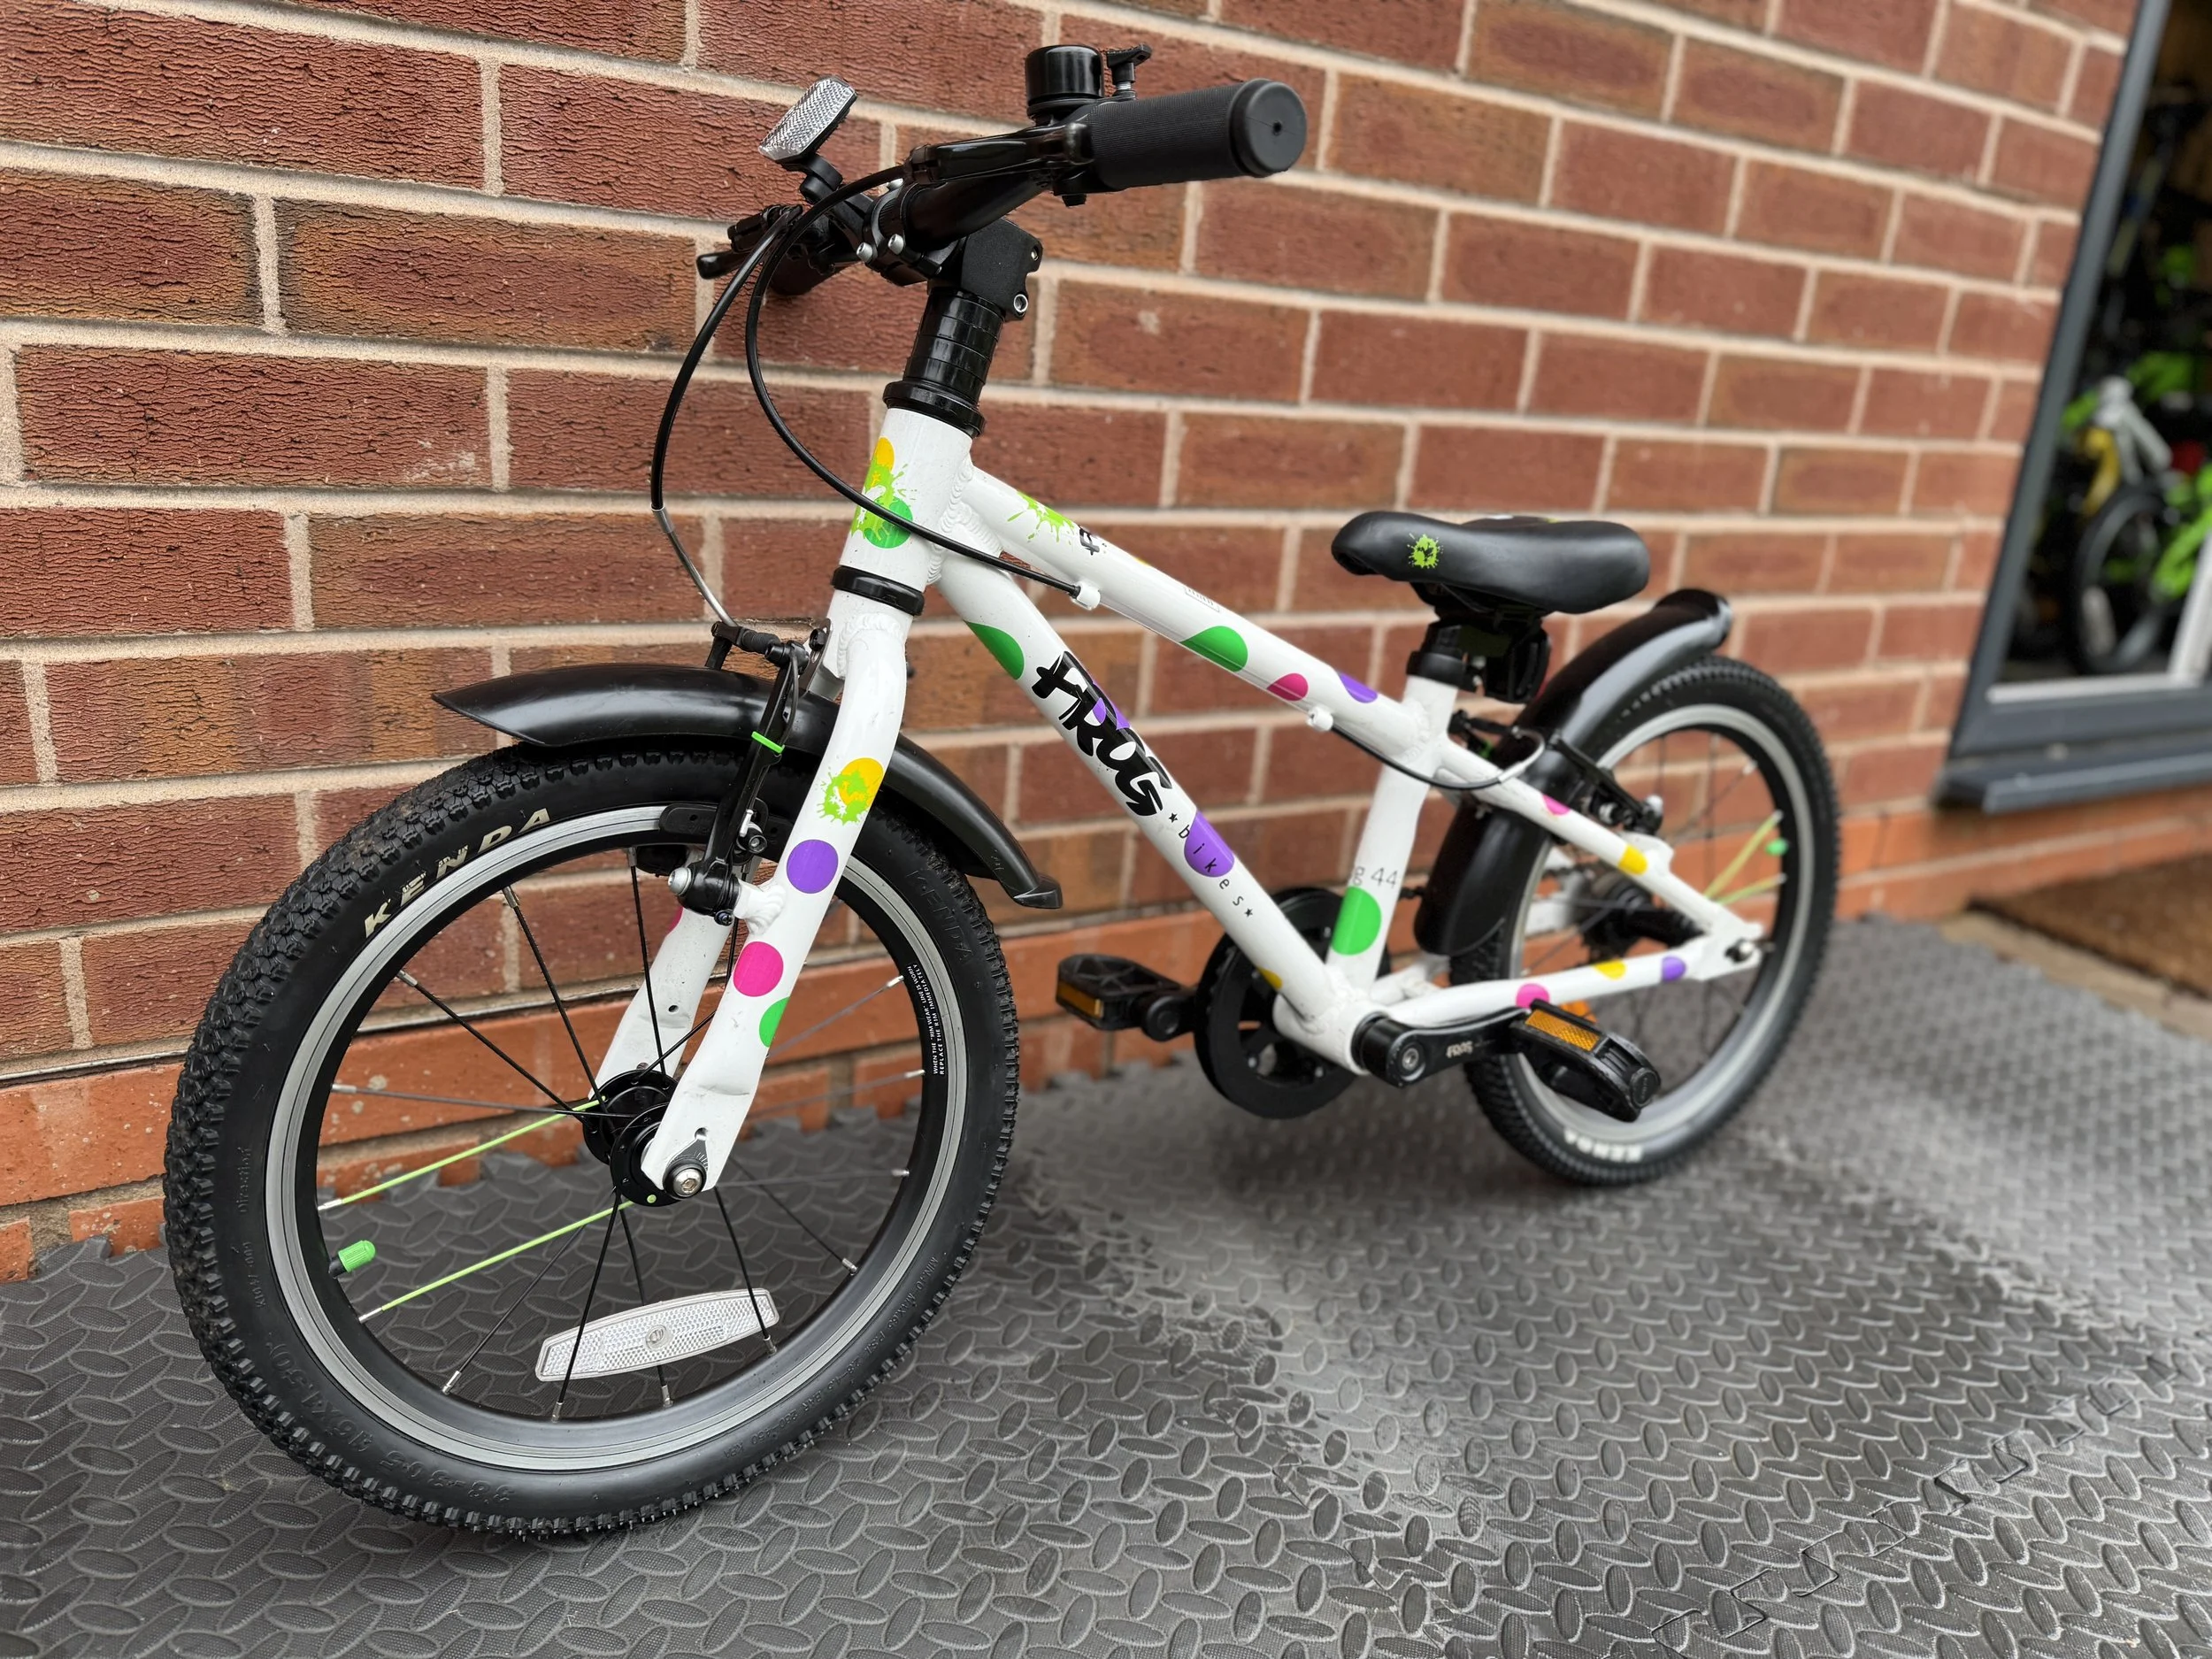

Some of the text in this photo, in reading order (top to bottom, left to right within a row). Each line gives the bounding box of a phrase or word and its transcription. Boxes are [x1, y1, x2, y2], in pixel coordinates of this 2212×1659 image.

[365, 808, 550, 938] KENDA
[1178, 824, 1245, 907] bikes
[1371, 866, 1398, 889] 44
[913, 964, 935, 1010] IMMEDIATELY
